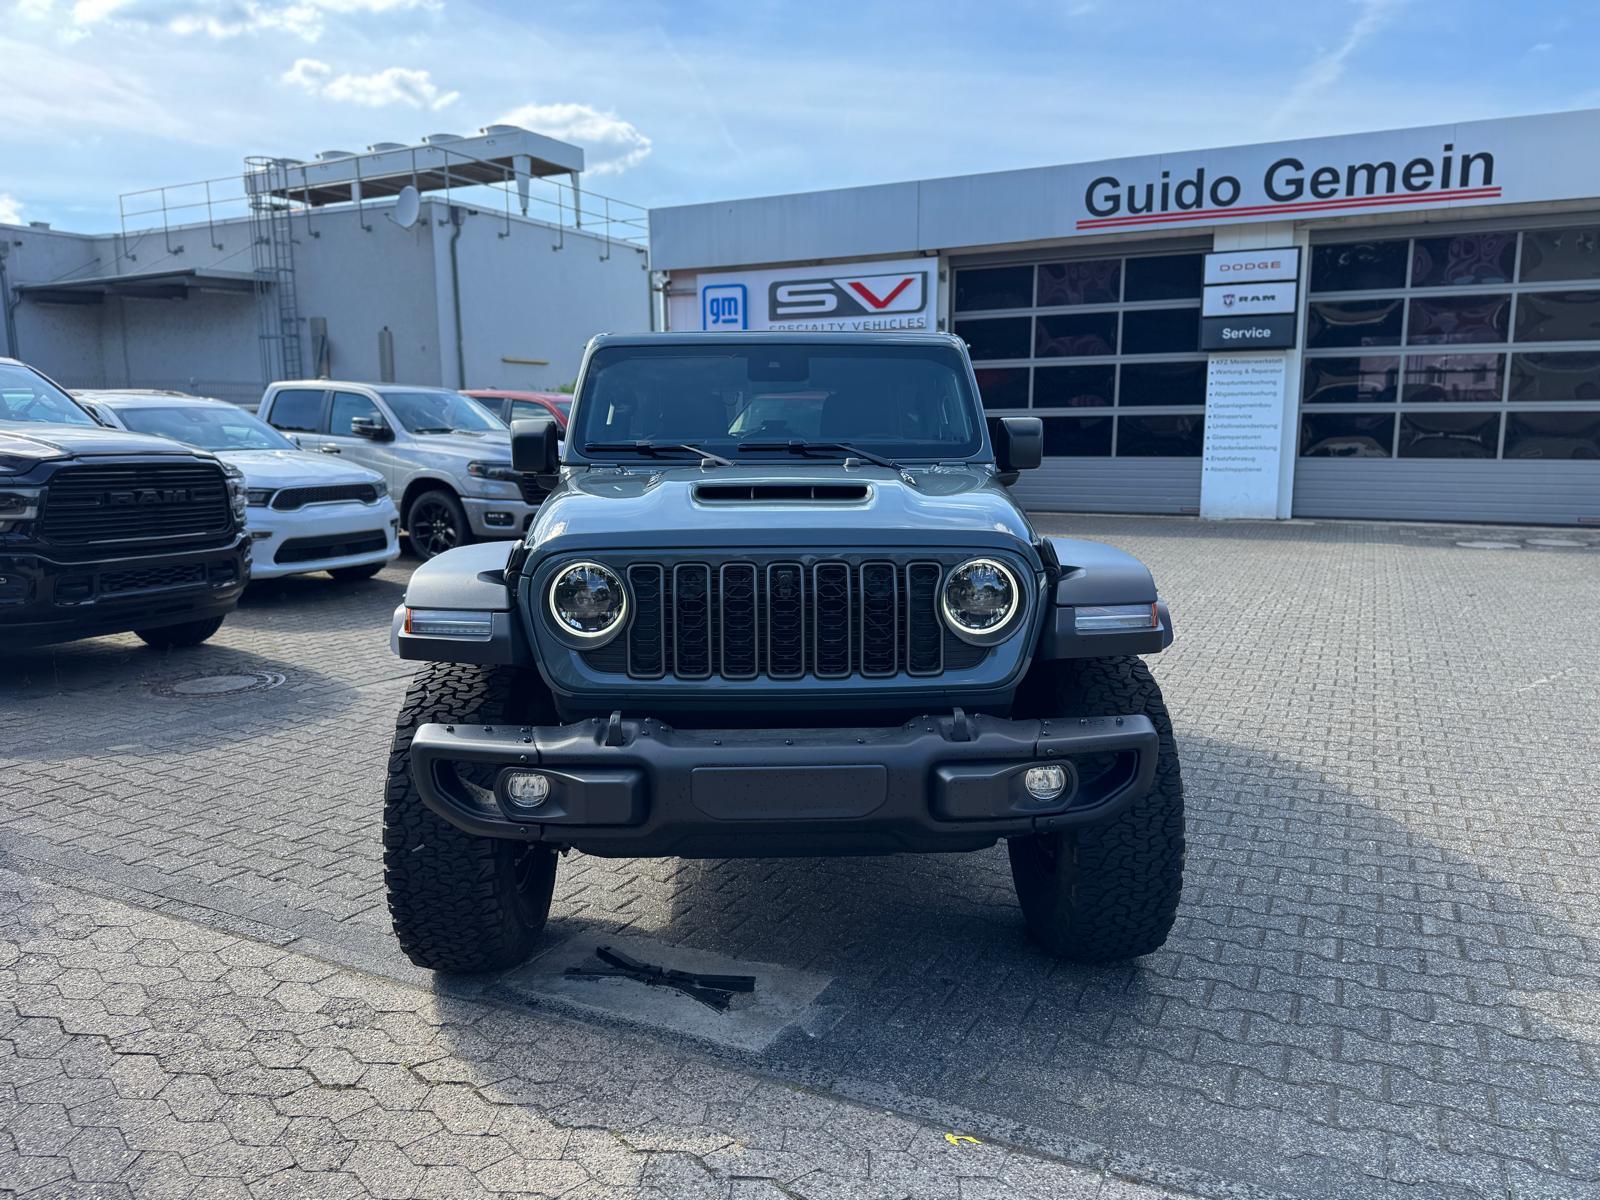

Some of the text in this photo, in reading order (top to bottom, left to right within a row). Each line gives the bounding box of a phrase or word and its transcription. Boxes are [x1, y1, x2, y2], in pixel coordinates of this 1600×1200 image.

[1084, 143, 1495, 218] Guido Gemein
[1219, 260, 1281, 272] DODGE
[1238, 294, 1276, 303] RAM
[710, 296, 738, 325] gm
[852, 317, 925, 331] VEHICLES
[1221, 326, 1272, 340] Service
[108, 488, 188, 506] RAM
